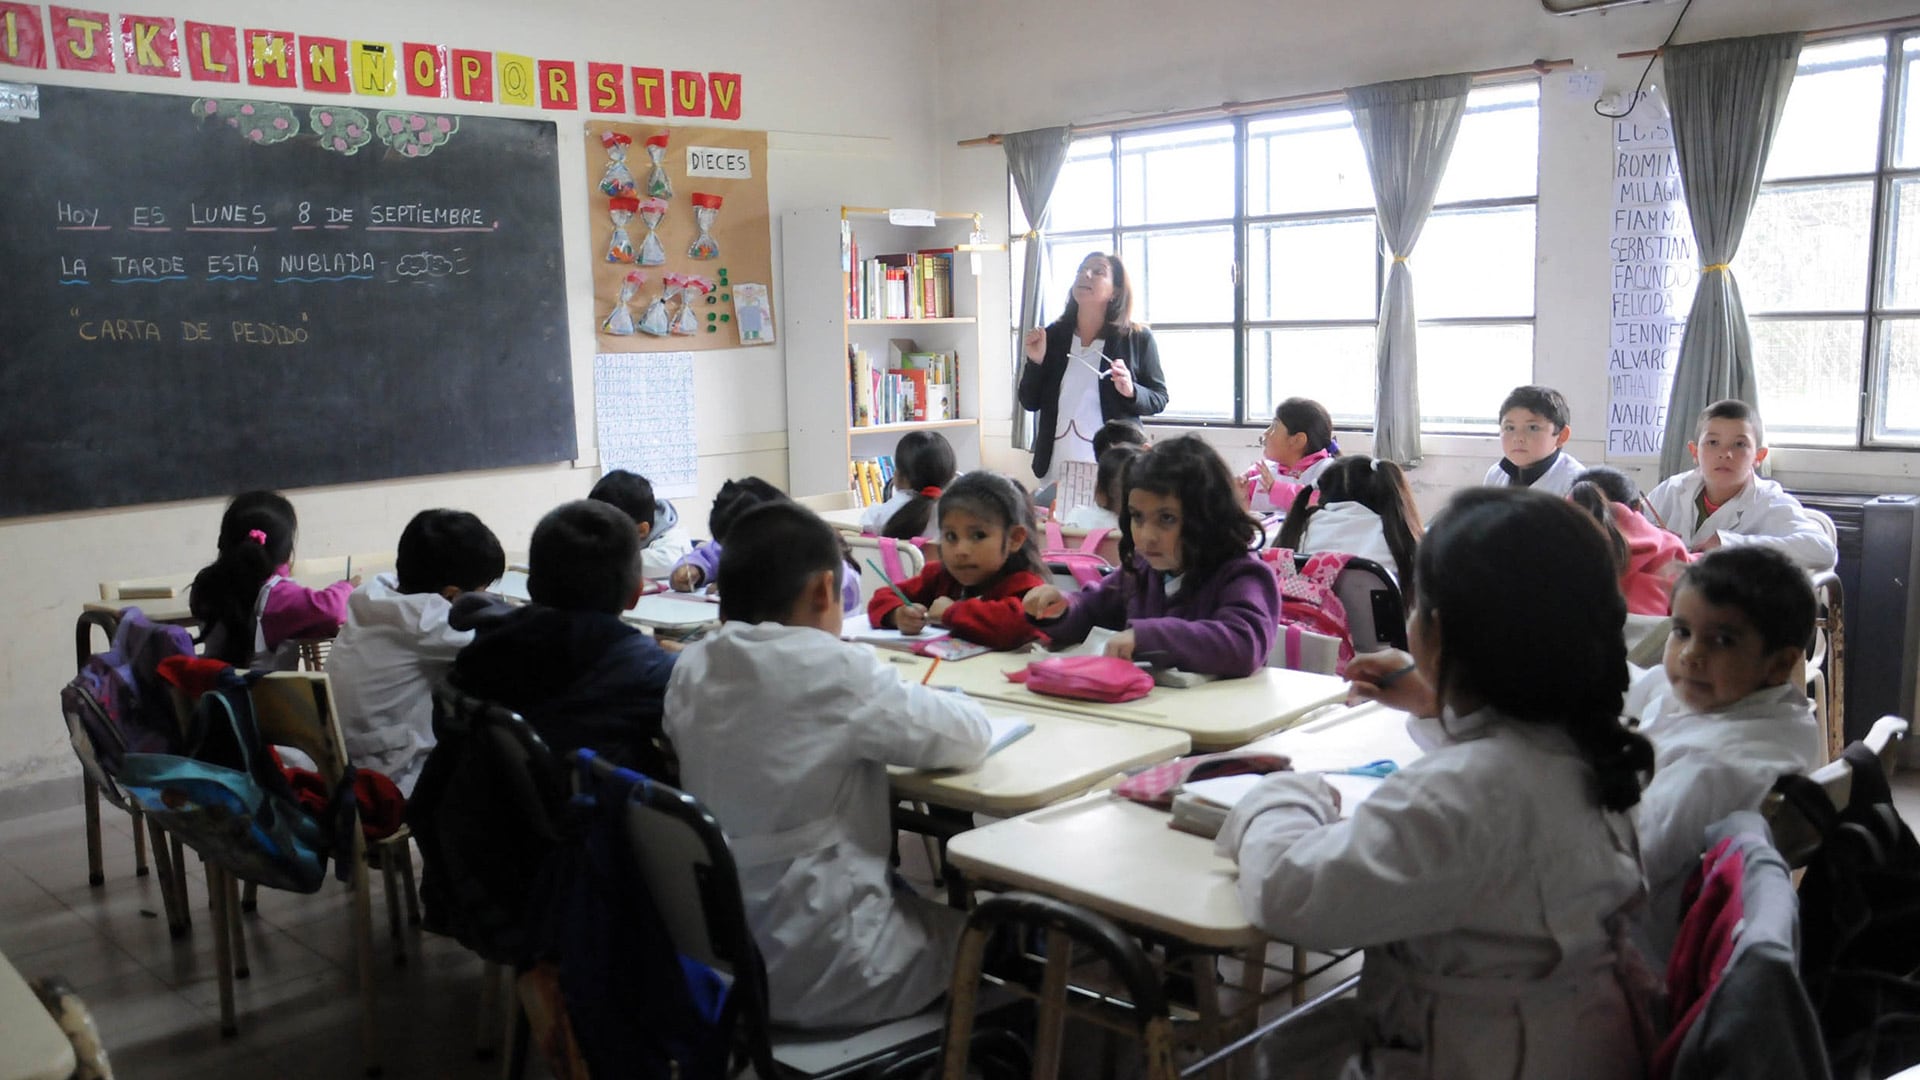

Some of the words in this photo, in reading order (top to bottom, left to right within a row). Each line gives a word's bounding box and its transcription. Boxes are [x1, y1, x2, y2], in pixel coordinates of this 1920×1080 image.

[5, 11, 18, 58] I
[66, 17, 103, 60] J
[135, 23, 165, 68] K
[201, 31, 228, 73] L
[252, 35, 288, 79] M
[309, 44, 337, 83] N
[414, 50, 435, 88] O
[462, 56, 481, 96] P
[503, 61, 528, 99] Q
[549, 67, 570, 103] R
[597, 72, 618, 110] S
[638, 76, 662, 109] T
[679, 78, 697, 110] U
[713, 79, 736, 111] V
[133, 206, 166, 226] ES
[191, 203, 267, 225] LUNES
[298, 201, 311, 223] 8
[326, 207, 353, 222] DE
[1611, 235, 1691, 262] SEBASTIAN
[61, 256, 88, 276] LA
[112, 256, 186, 276] TARDE
[1615, 264, 1693, 289] FACUNDO
[181, 321, 213, 341] DE
[1610, 348, 1673, 370] ALVARO
